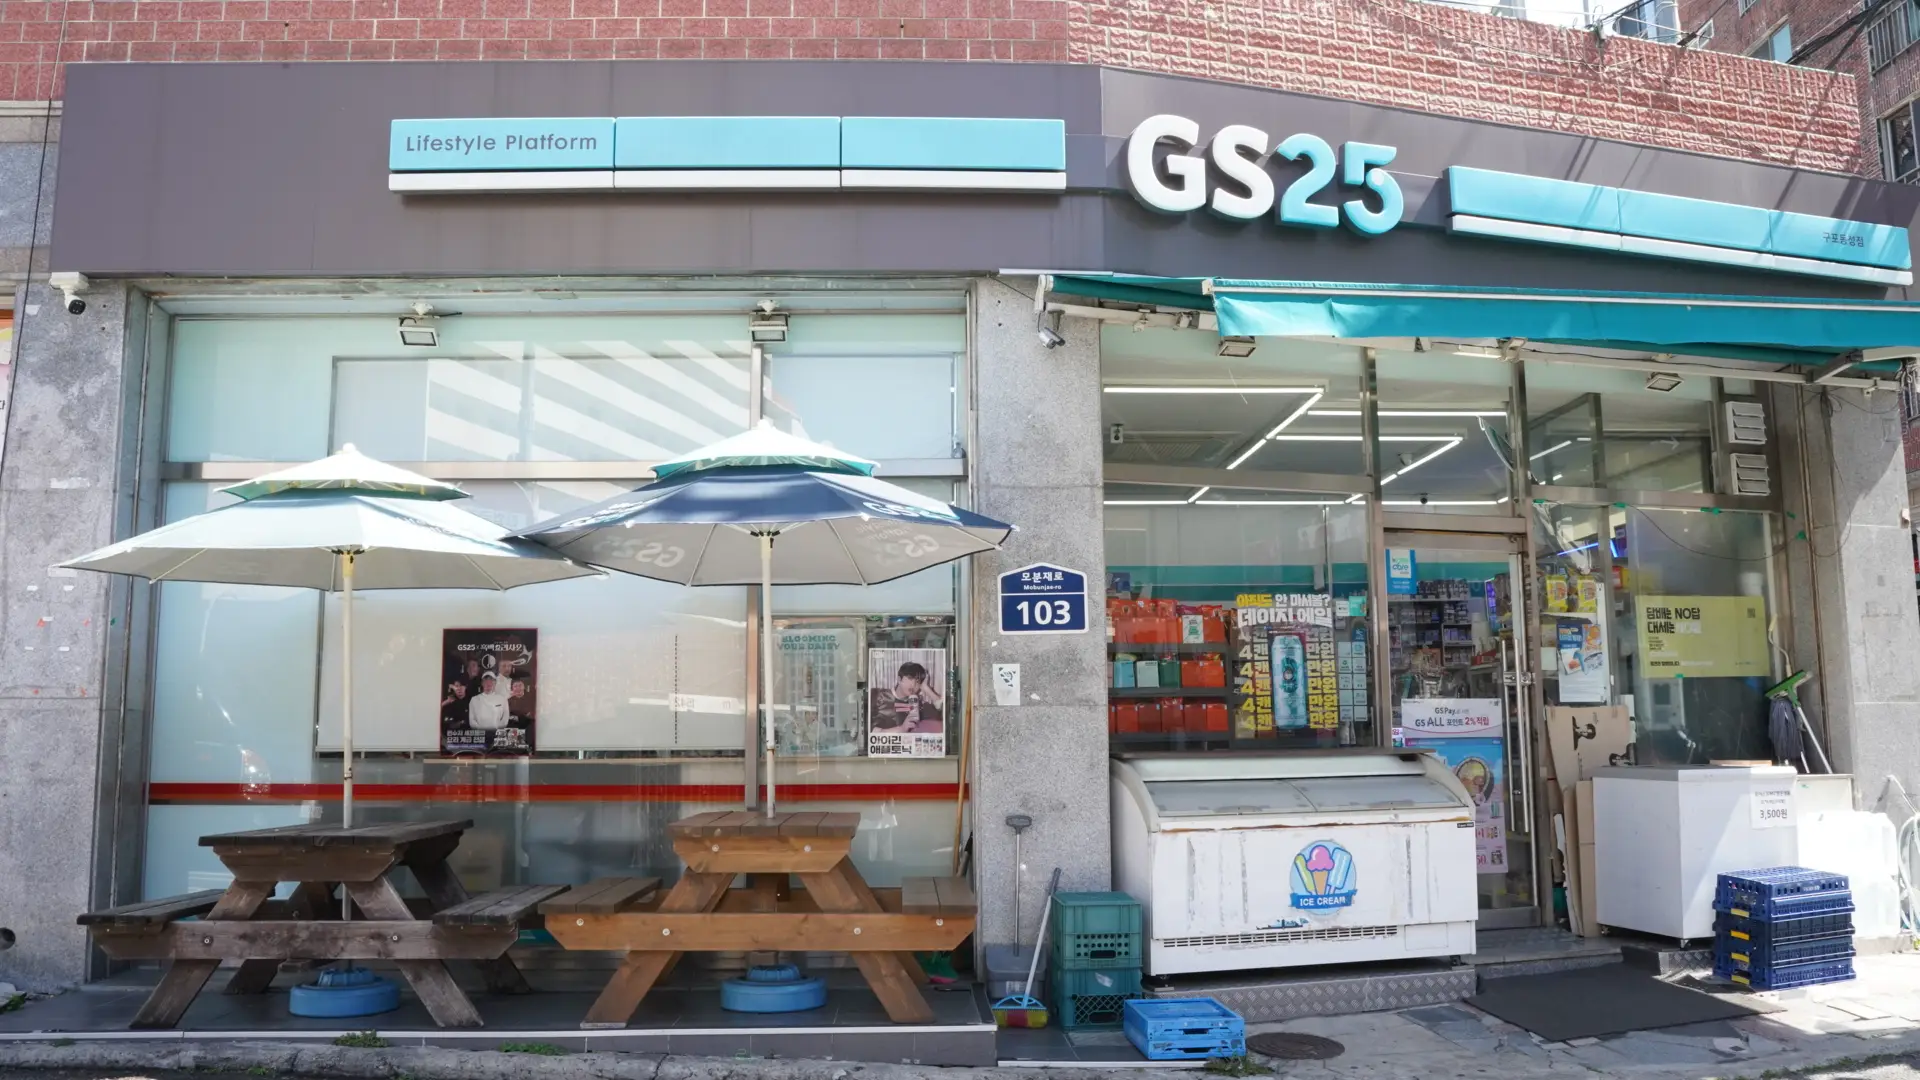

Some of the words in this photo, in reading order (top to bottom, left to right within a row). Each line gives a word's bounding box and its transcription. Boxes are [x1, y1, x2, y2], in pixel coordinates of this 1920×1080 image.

[406, 135, 497, 155] Lifestyle
[505, 134, 598, 150] Platform
[1127, 114, 1404, 234] GS25
[1021, 571, 1064, 583] 모분재로
[1275, 593, 1287, 607] 안
[1016, 600, 1071, 625] 103
[1647, 607, 1672, 619] 담배는
[1647, 621, 1675, 634] 대세는
[1427, 717, 1444, 727] ALL
[1760, 809, 1787, 820] 3,500원
[1300, 898, 1314, 906] ICE
[1316, 896, 1346, 905] CREAM
